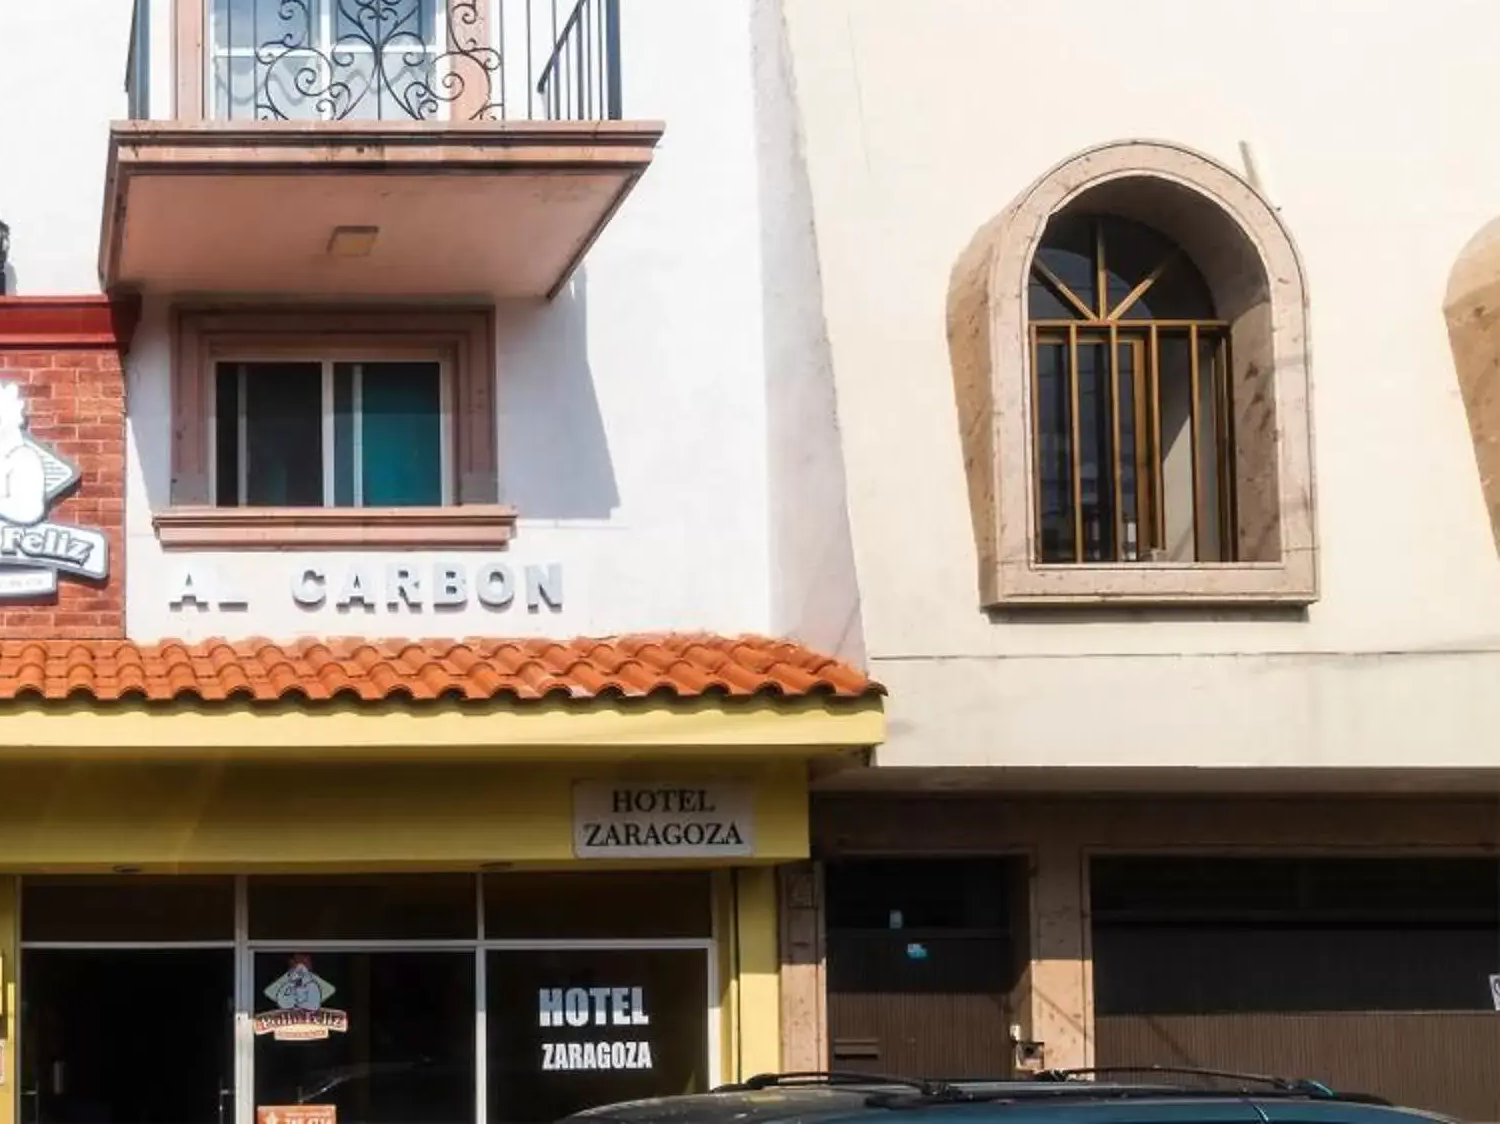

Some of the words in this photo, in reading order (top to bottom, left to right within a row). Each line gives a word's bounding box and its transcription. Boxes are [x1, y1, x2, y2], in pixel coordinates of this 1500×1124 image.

[1, 526, 96, 567] Feliz
[168, 562, 249, 612] AL
[290, 562, 563, 614] CARBON
[611, 788, 717, 814] HOTEL
[585, 821, 744, 848] ZARAGOZA
[539, 986, 650, 1027] HOTEL
[541, 1040, 653, 1071] ZARAGOZA
